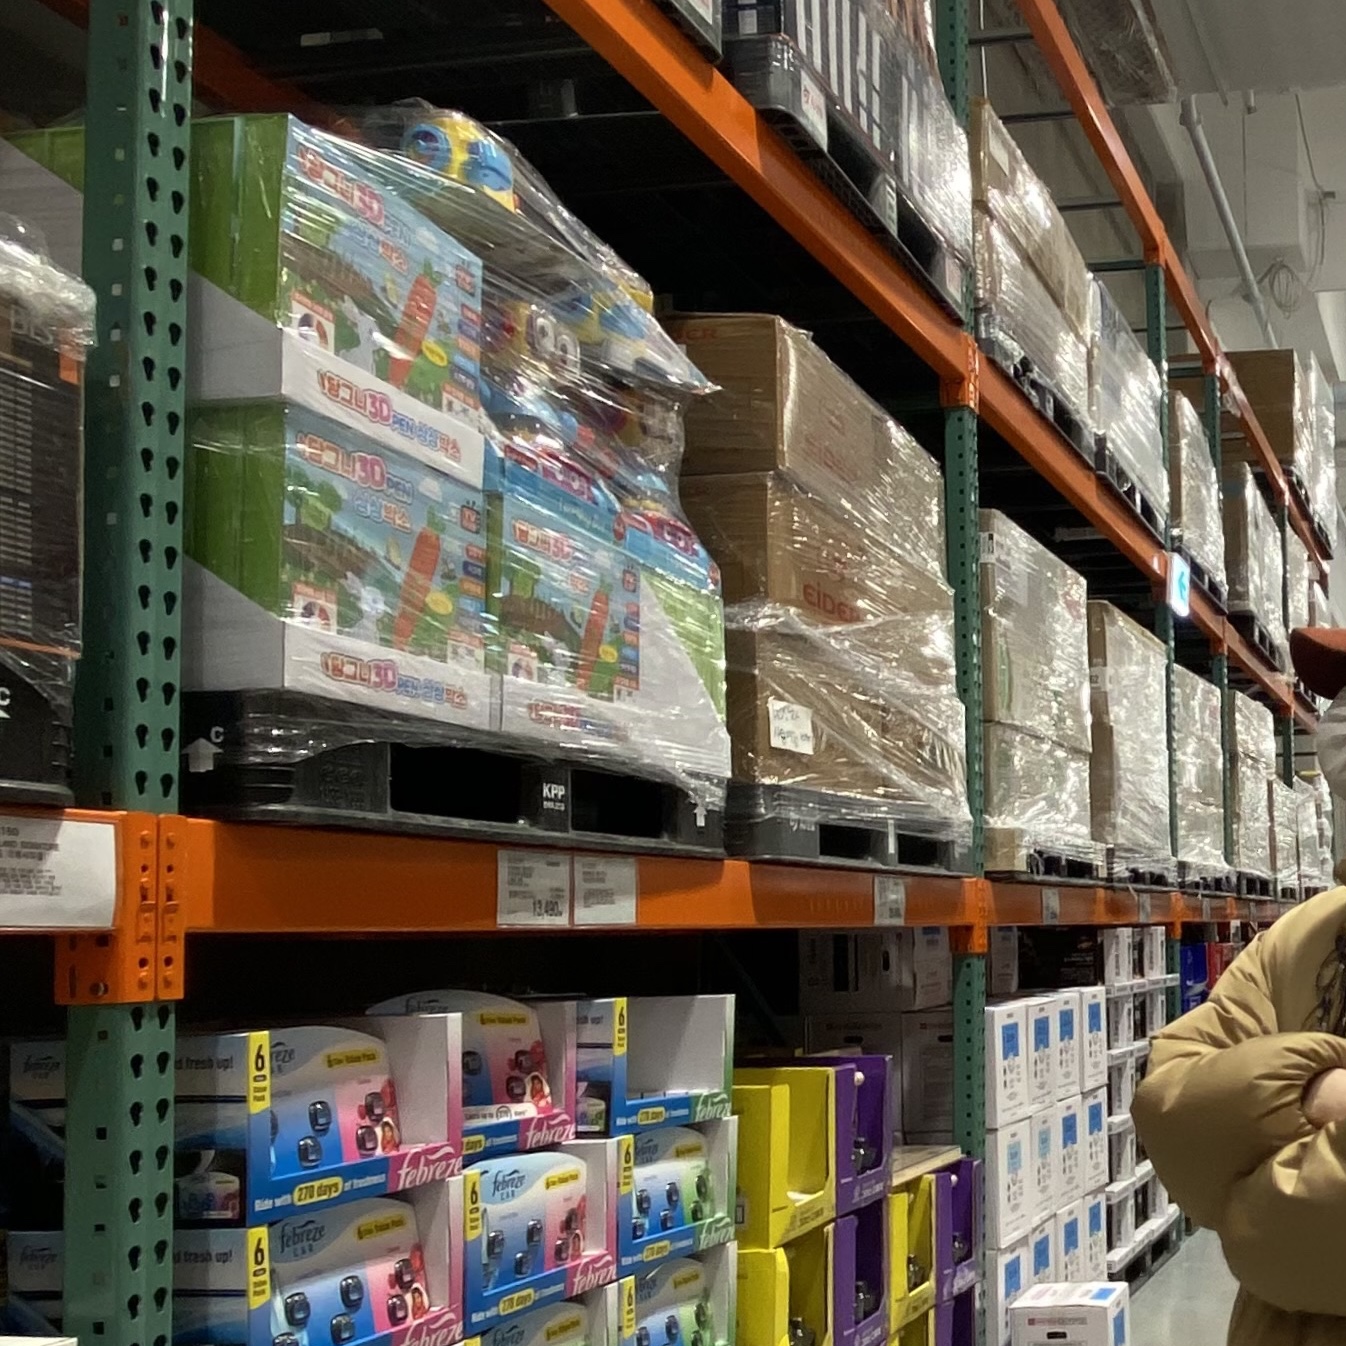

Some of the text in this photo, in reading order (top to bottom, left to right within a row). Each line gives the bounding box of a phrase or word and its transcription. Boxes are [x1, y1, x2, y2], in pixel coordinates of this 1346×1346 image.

[210, 726, 225, 744] C
[542, 782, 566, 800] KPP
[618, 1006, 625, 1027] 6
[254, 1044, 265, 1072] 6
[270, 1041, 296, 1063] reze
[185, 1056, 234, 1071] fresh up!
[525, 1113, 576, 1150] febreze
[624, 1143, 632, 1165] 6
[397, 1145, 464, 1190] febreze
[297, 1184, 315, 1202] 270
[316, 1181, 340, 1200] days
[470, 1181, 479, 1205] 6
[491, 1168, 526, 1198] febreze
[279, 1218, 327, 1254] febreze
[215, 1249, 233, 1266] up!
[254, 1236, 265, 1266] 6
[572, 1254, 617, 1298] febreze
[627, 1286, 634, 1308] 6
